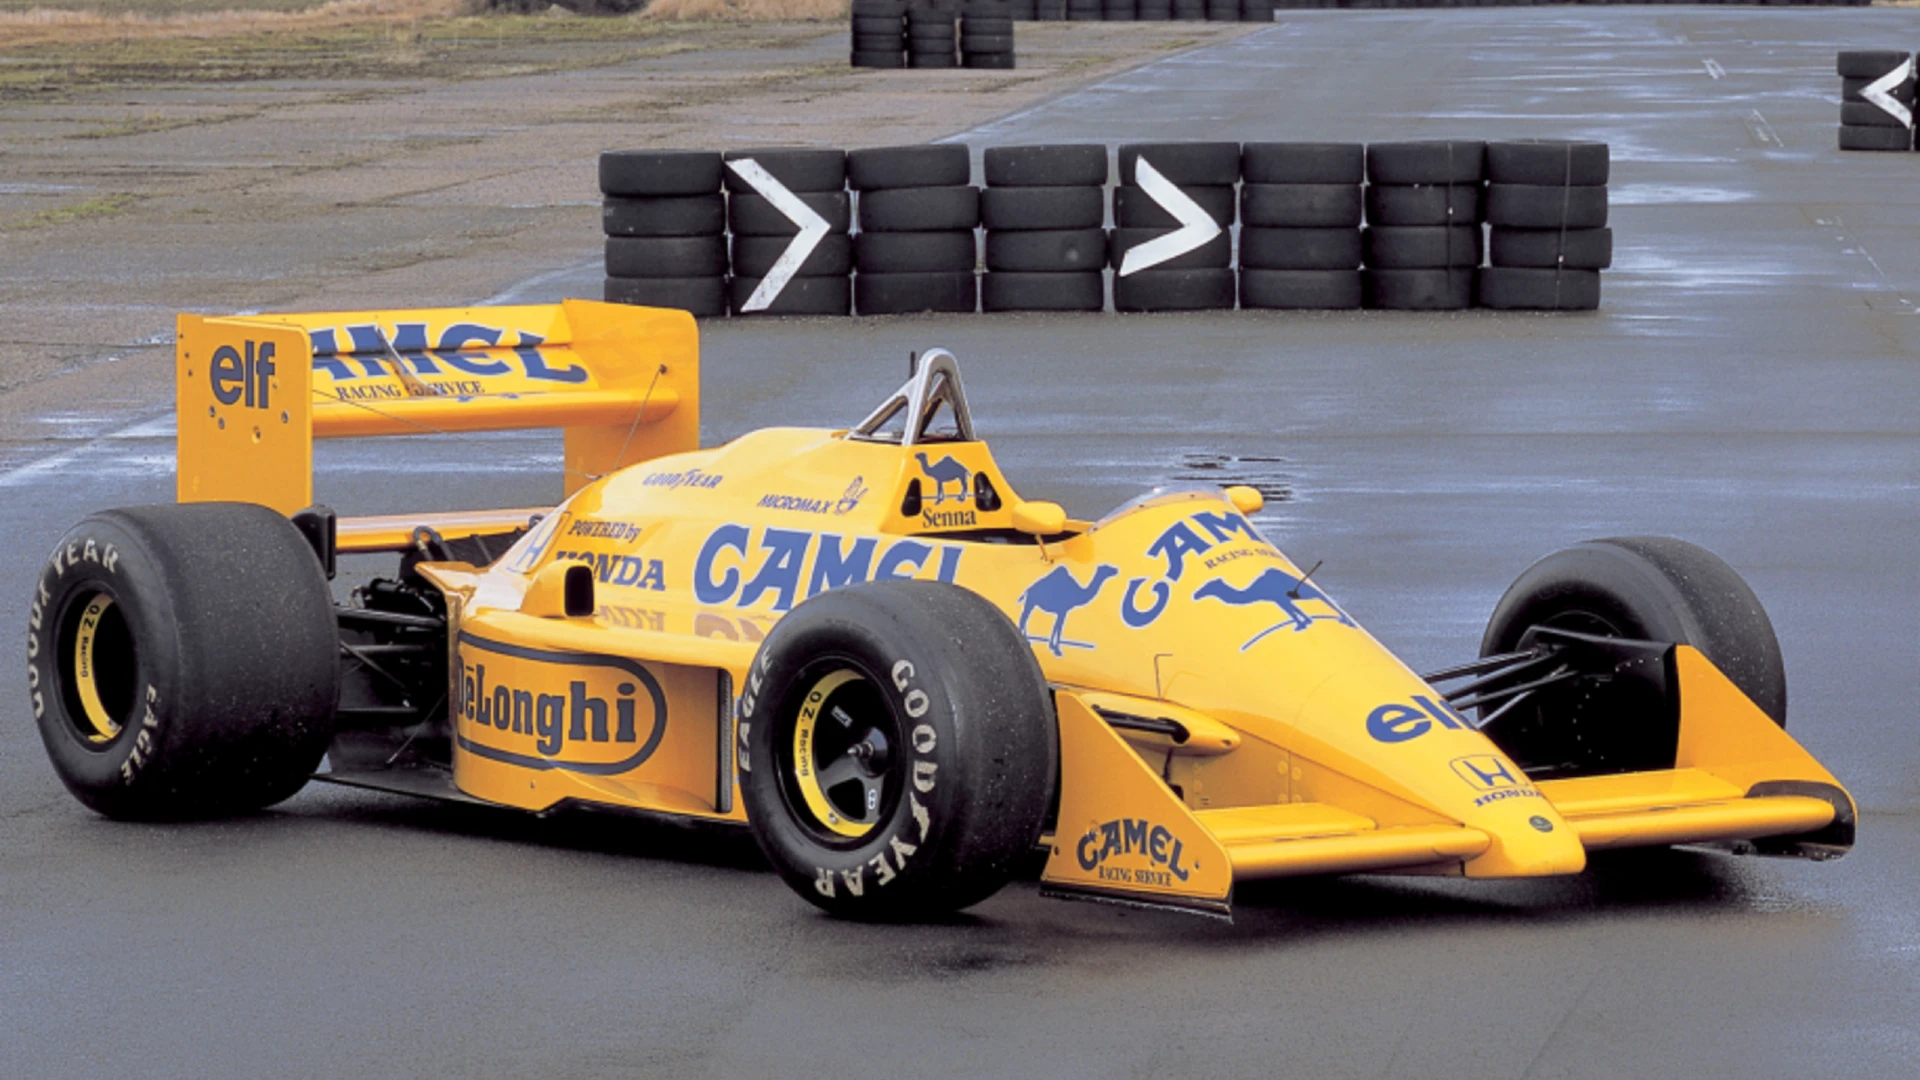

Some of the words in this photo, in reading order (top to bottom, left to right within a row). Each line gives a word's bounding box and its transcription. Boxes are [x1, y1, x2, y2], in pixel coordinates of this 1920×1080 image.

[209, 339, 276, 409] elf
[335, 383, 402, 401] RACING
[922, 507, 976, 528] Senna
[738, 644, 773, 772] EAGLE
[890, 658, 940, 794] GOOD
[813, 834, 918, 898] YEAR
[1076, 818, 1189, 882] CAMEL
[1099, 864, 1132, 882] RACING
